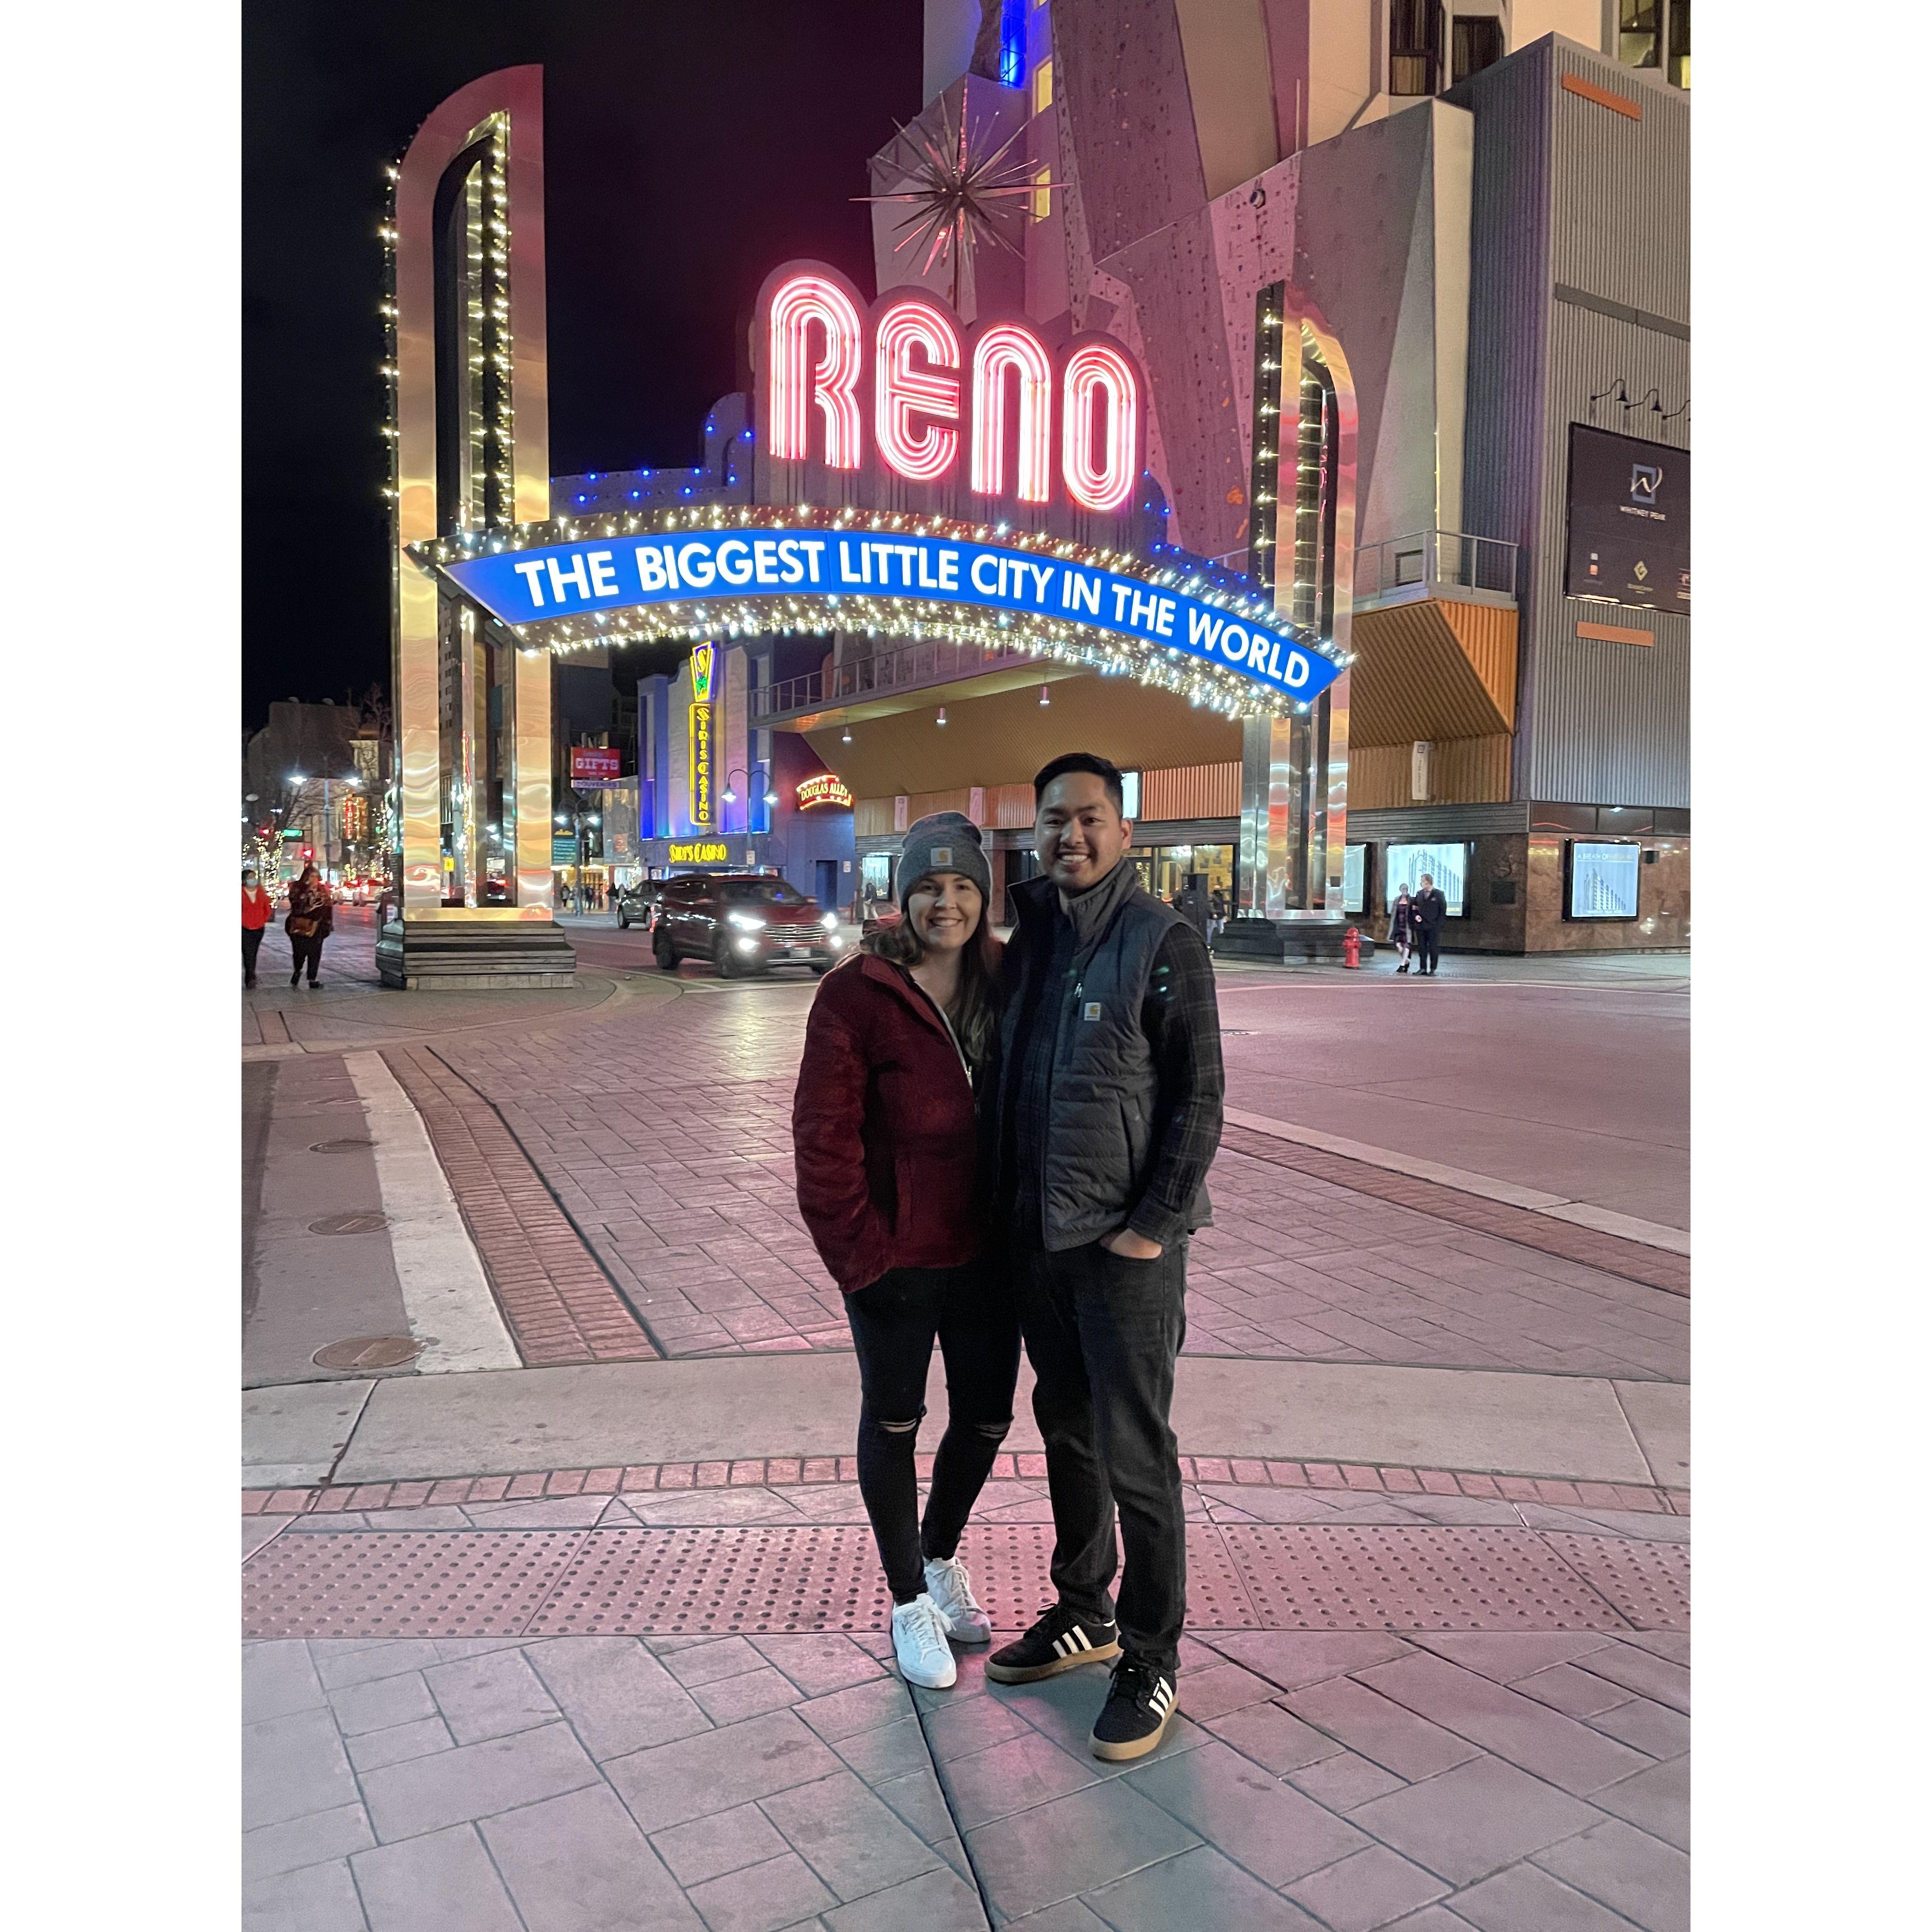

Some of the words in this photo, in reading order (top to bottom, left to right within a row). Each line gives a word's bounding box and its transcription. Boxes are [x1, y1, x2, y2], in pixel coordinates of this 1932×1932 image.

[769, 275, 1137, 511] RENO
[514, 551, 620, 607] THE
[634, 539, 825, 591] BIGGEST
[839, 541, 959, 591] LITTLE
[970, 554, 1055, 603] CITY
[1062, 570, 1102, 615] IN
[1111, 583, 1176, 637] THE
[1188, 607, 1310, 688] WORLD
[575, 758, 619, 770] GIFTS
[697, 761, 709, 821] CASINO
[801, 782, 828, 802] DOUGLAS
[694, 843, 727, 862] CASINO
